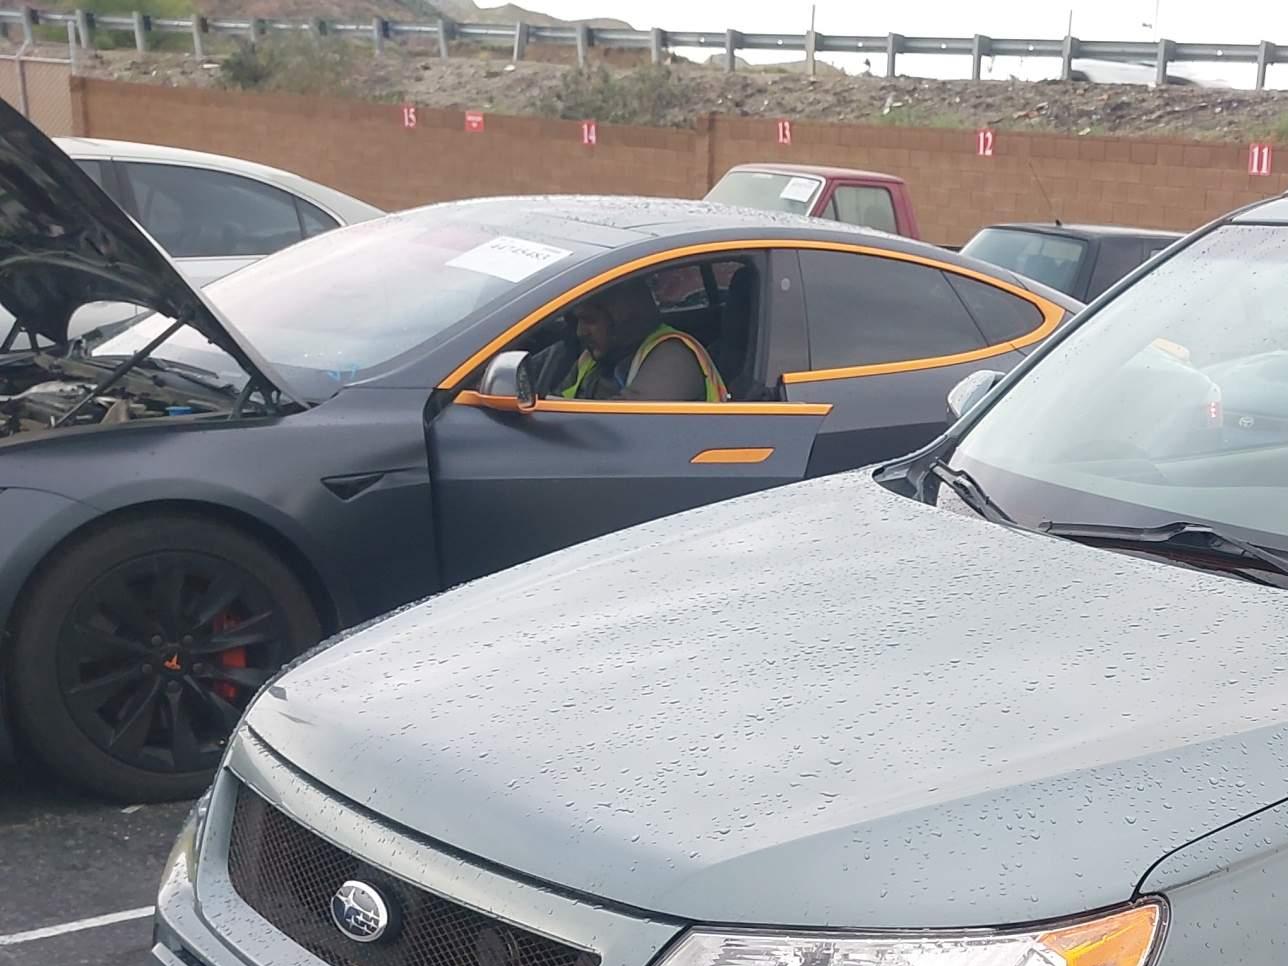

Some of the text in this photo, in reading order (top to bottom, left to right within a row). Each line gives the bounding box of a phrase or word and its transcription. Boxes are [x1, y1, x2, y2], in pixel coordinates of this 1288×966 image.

[403, 108, 417, 128] 15
[581, 122, 597, 145] 14
[778, 121, 791, 144] 13
[978, 131, 993, 157] 12
[1252, 145, 1269, 173] 11
